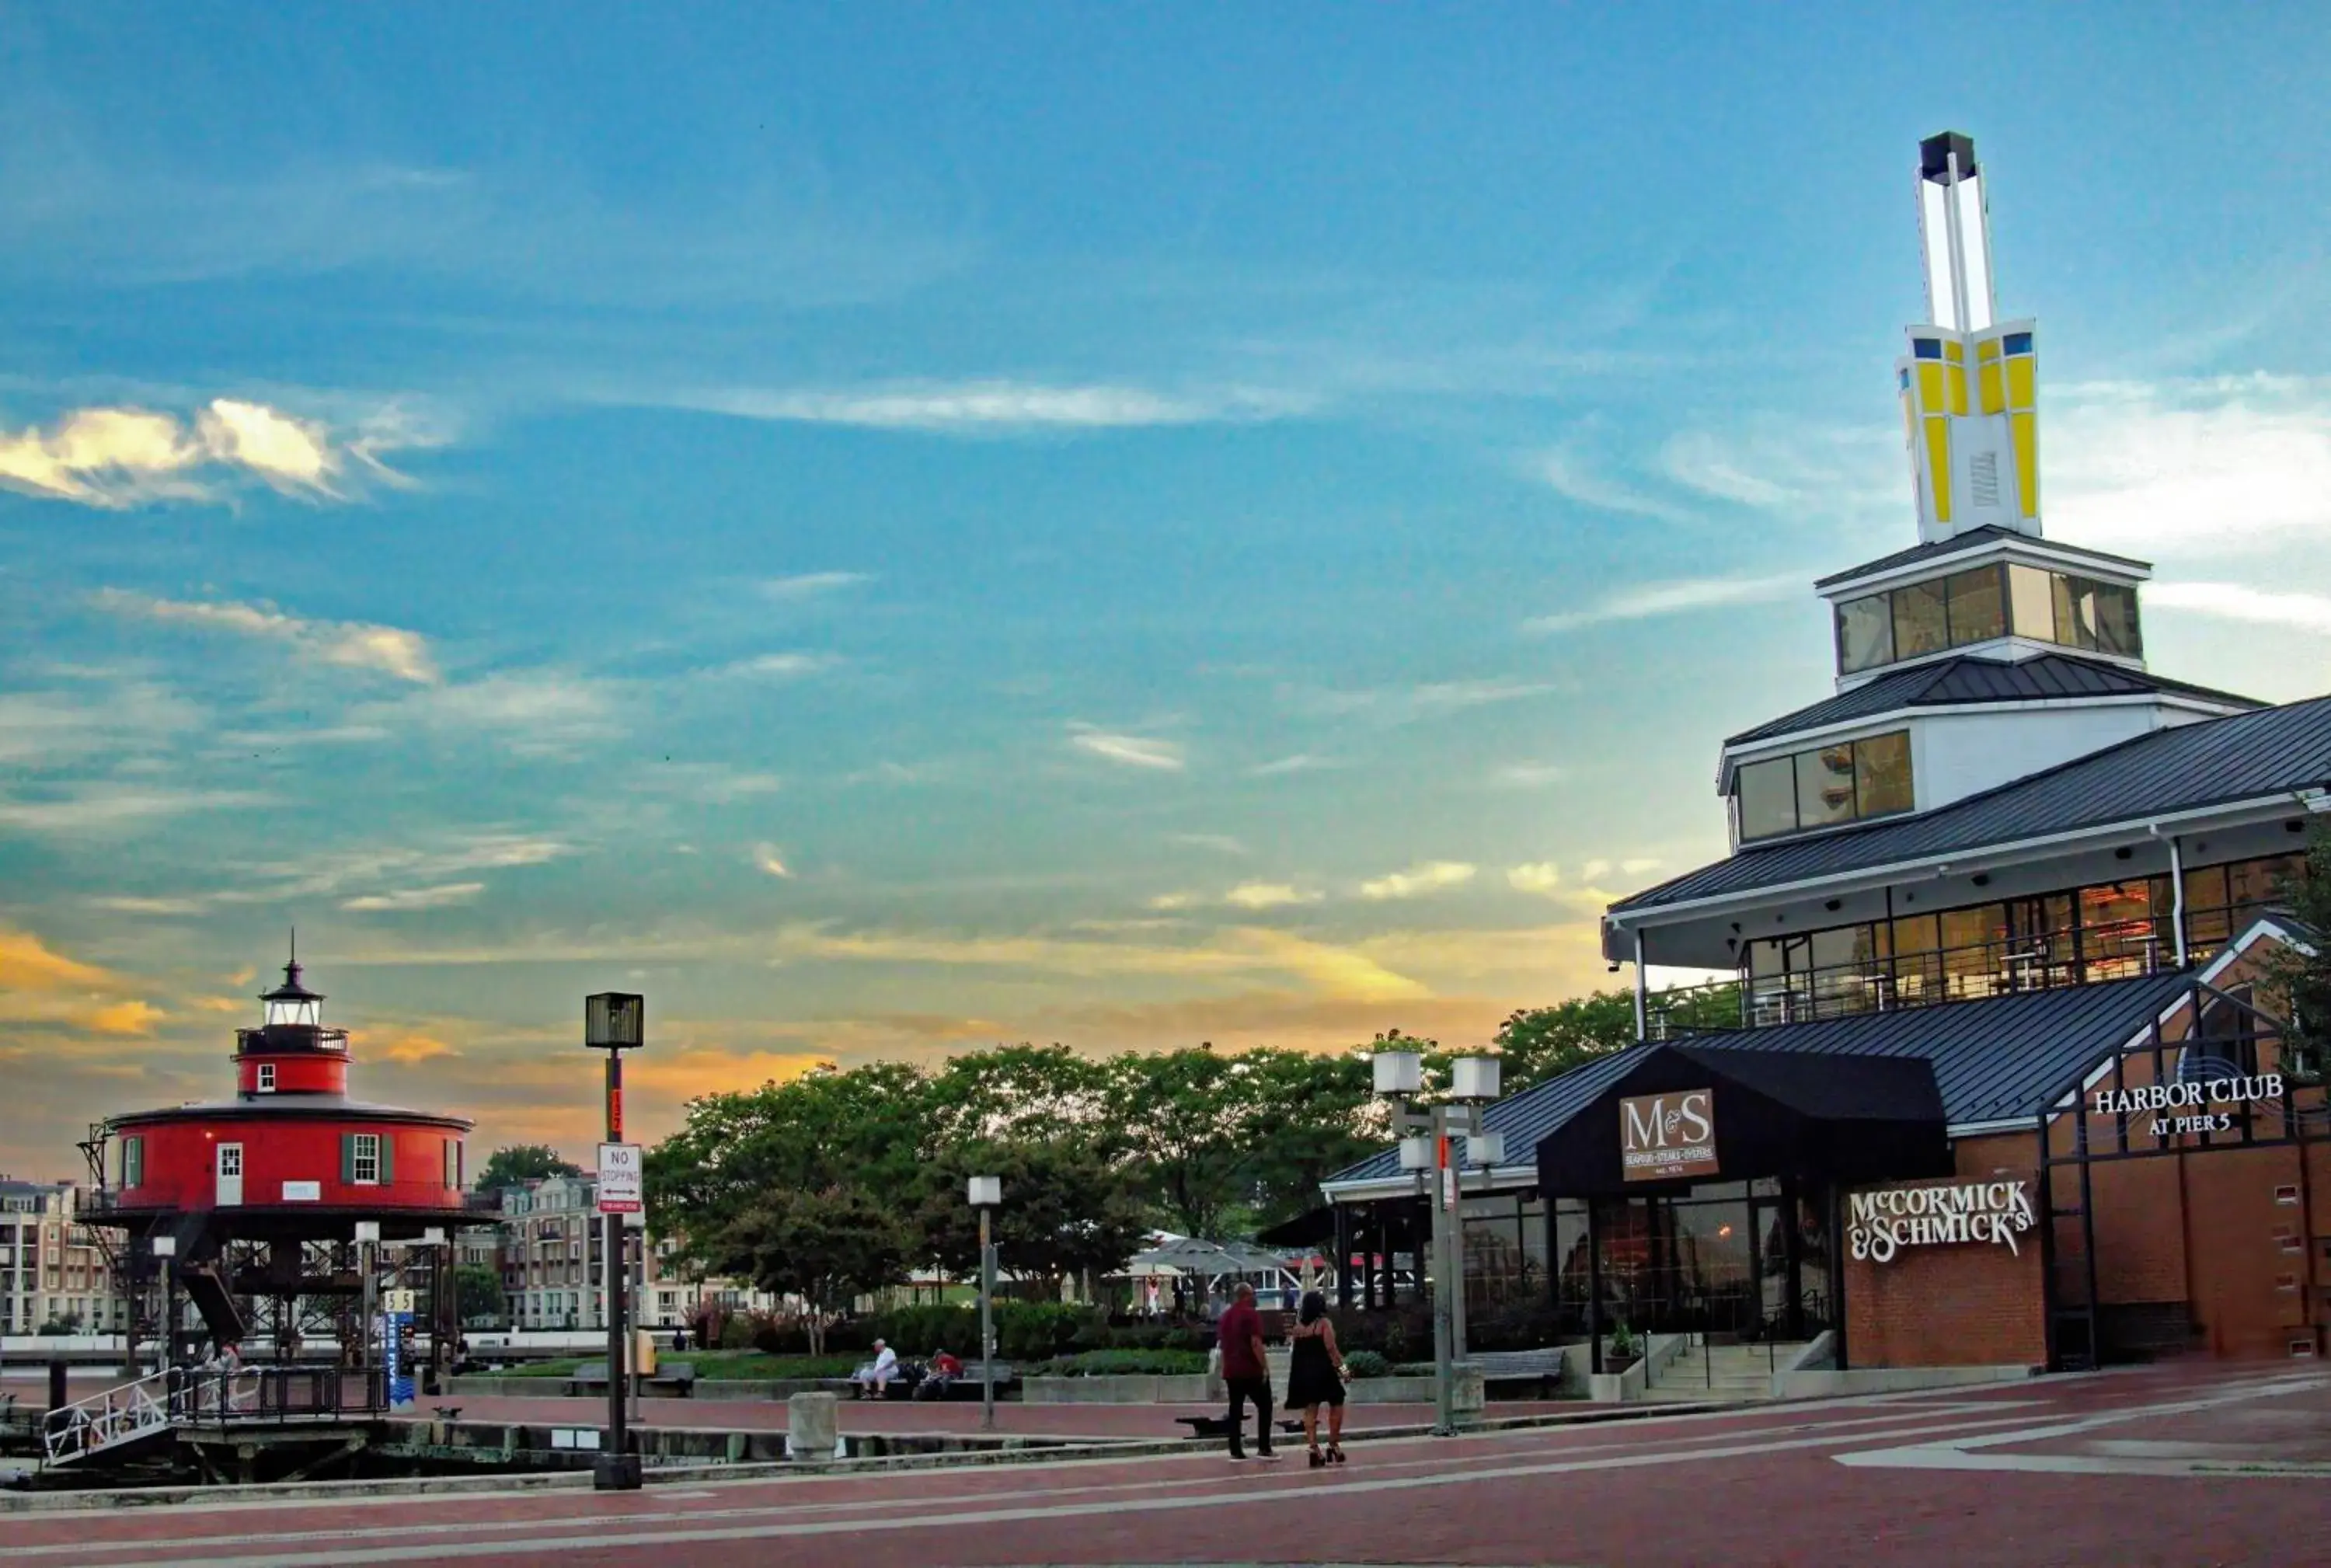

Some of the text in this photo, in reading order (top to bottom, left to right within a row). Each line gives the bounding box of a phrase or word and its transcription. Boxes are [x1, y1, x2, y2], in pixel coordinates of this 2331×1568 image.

[2095, 1073, 2284, 1114] HARBOR CLUB
[1625, 1094, 1711, 1150] M&S
[2149, 1113, 2231, 1136] AT PIER 5
[611, 1151, 629, 1164] NO
[402, 1292, 410, 1309] 5
